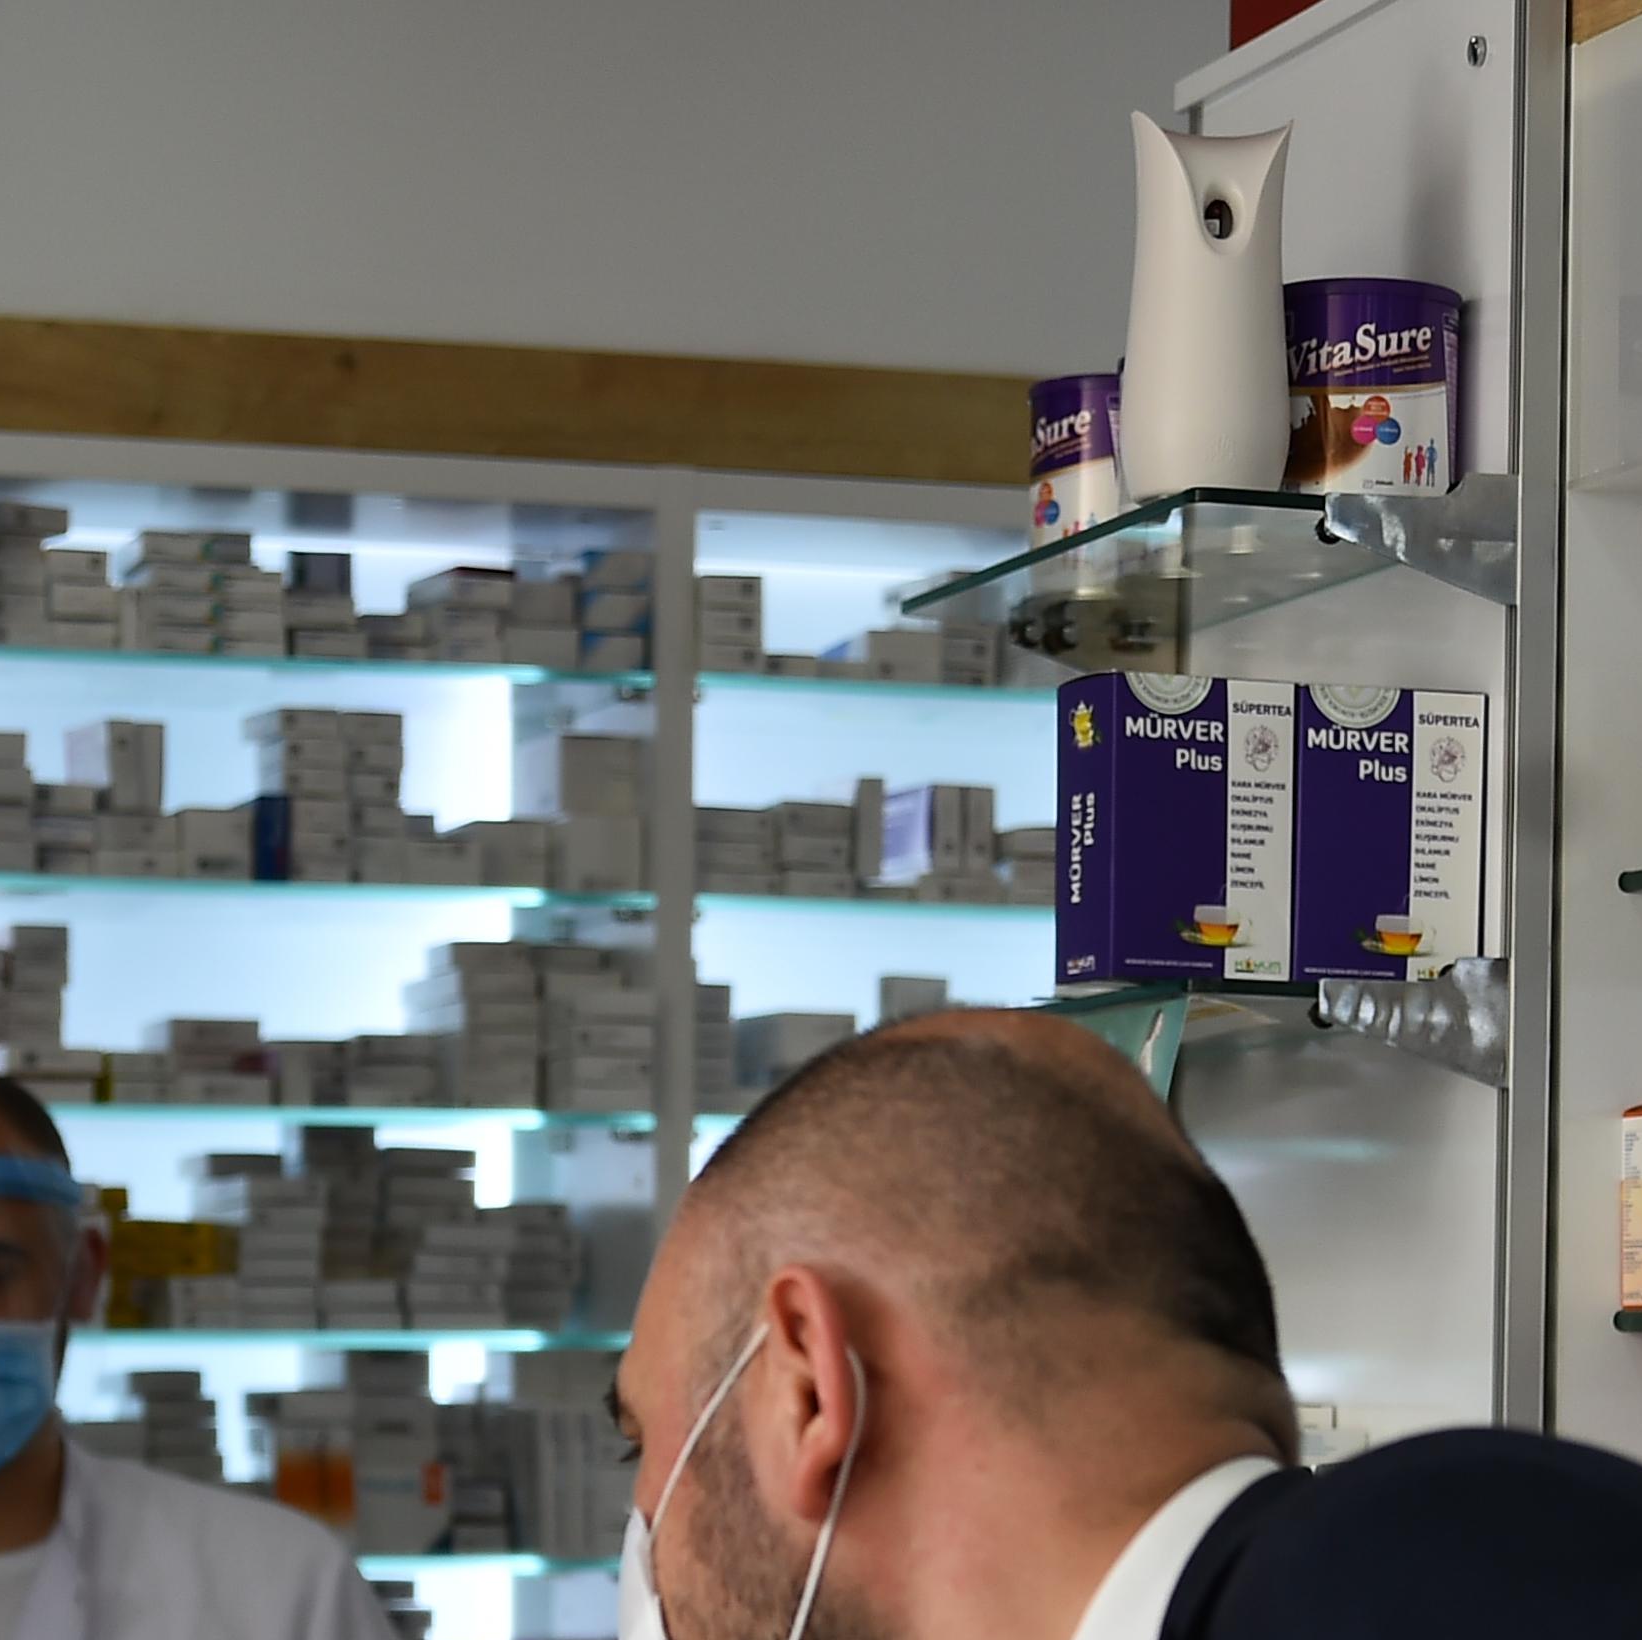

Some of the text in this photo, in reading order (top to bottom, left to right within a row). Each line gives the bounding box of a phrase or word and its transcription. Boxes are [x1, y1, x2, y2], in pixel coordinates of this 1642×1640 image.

[1287, 323, 1433, 382] VitaSure
[1232, 702, 1292, 717] SÜPERTEA
[1418, 713, 1480, 729] SÜPERTEA
[1125, 713, 1225, 743] MÜRVER
[1307, 724, 1409, 754] MÜRVER
[1175, 748, 1223, 771] Plus
[1358, 759, 1407, 783] Plus
[1083, 792, 1095, 846] Plus
[1071, 792, 1082, 904] MÜRVER
